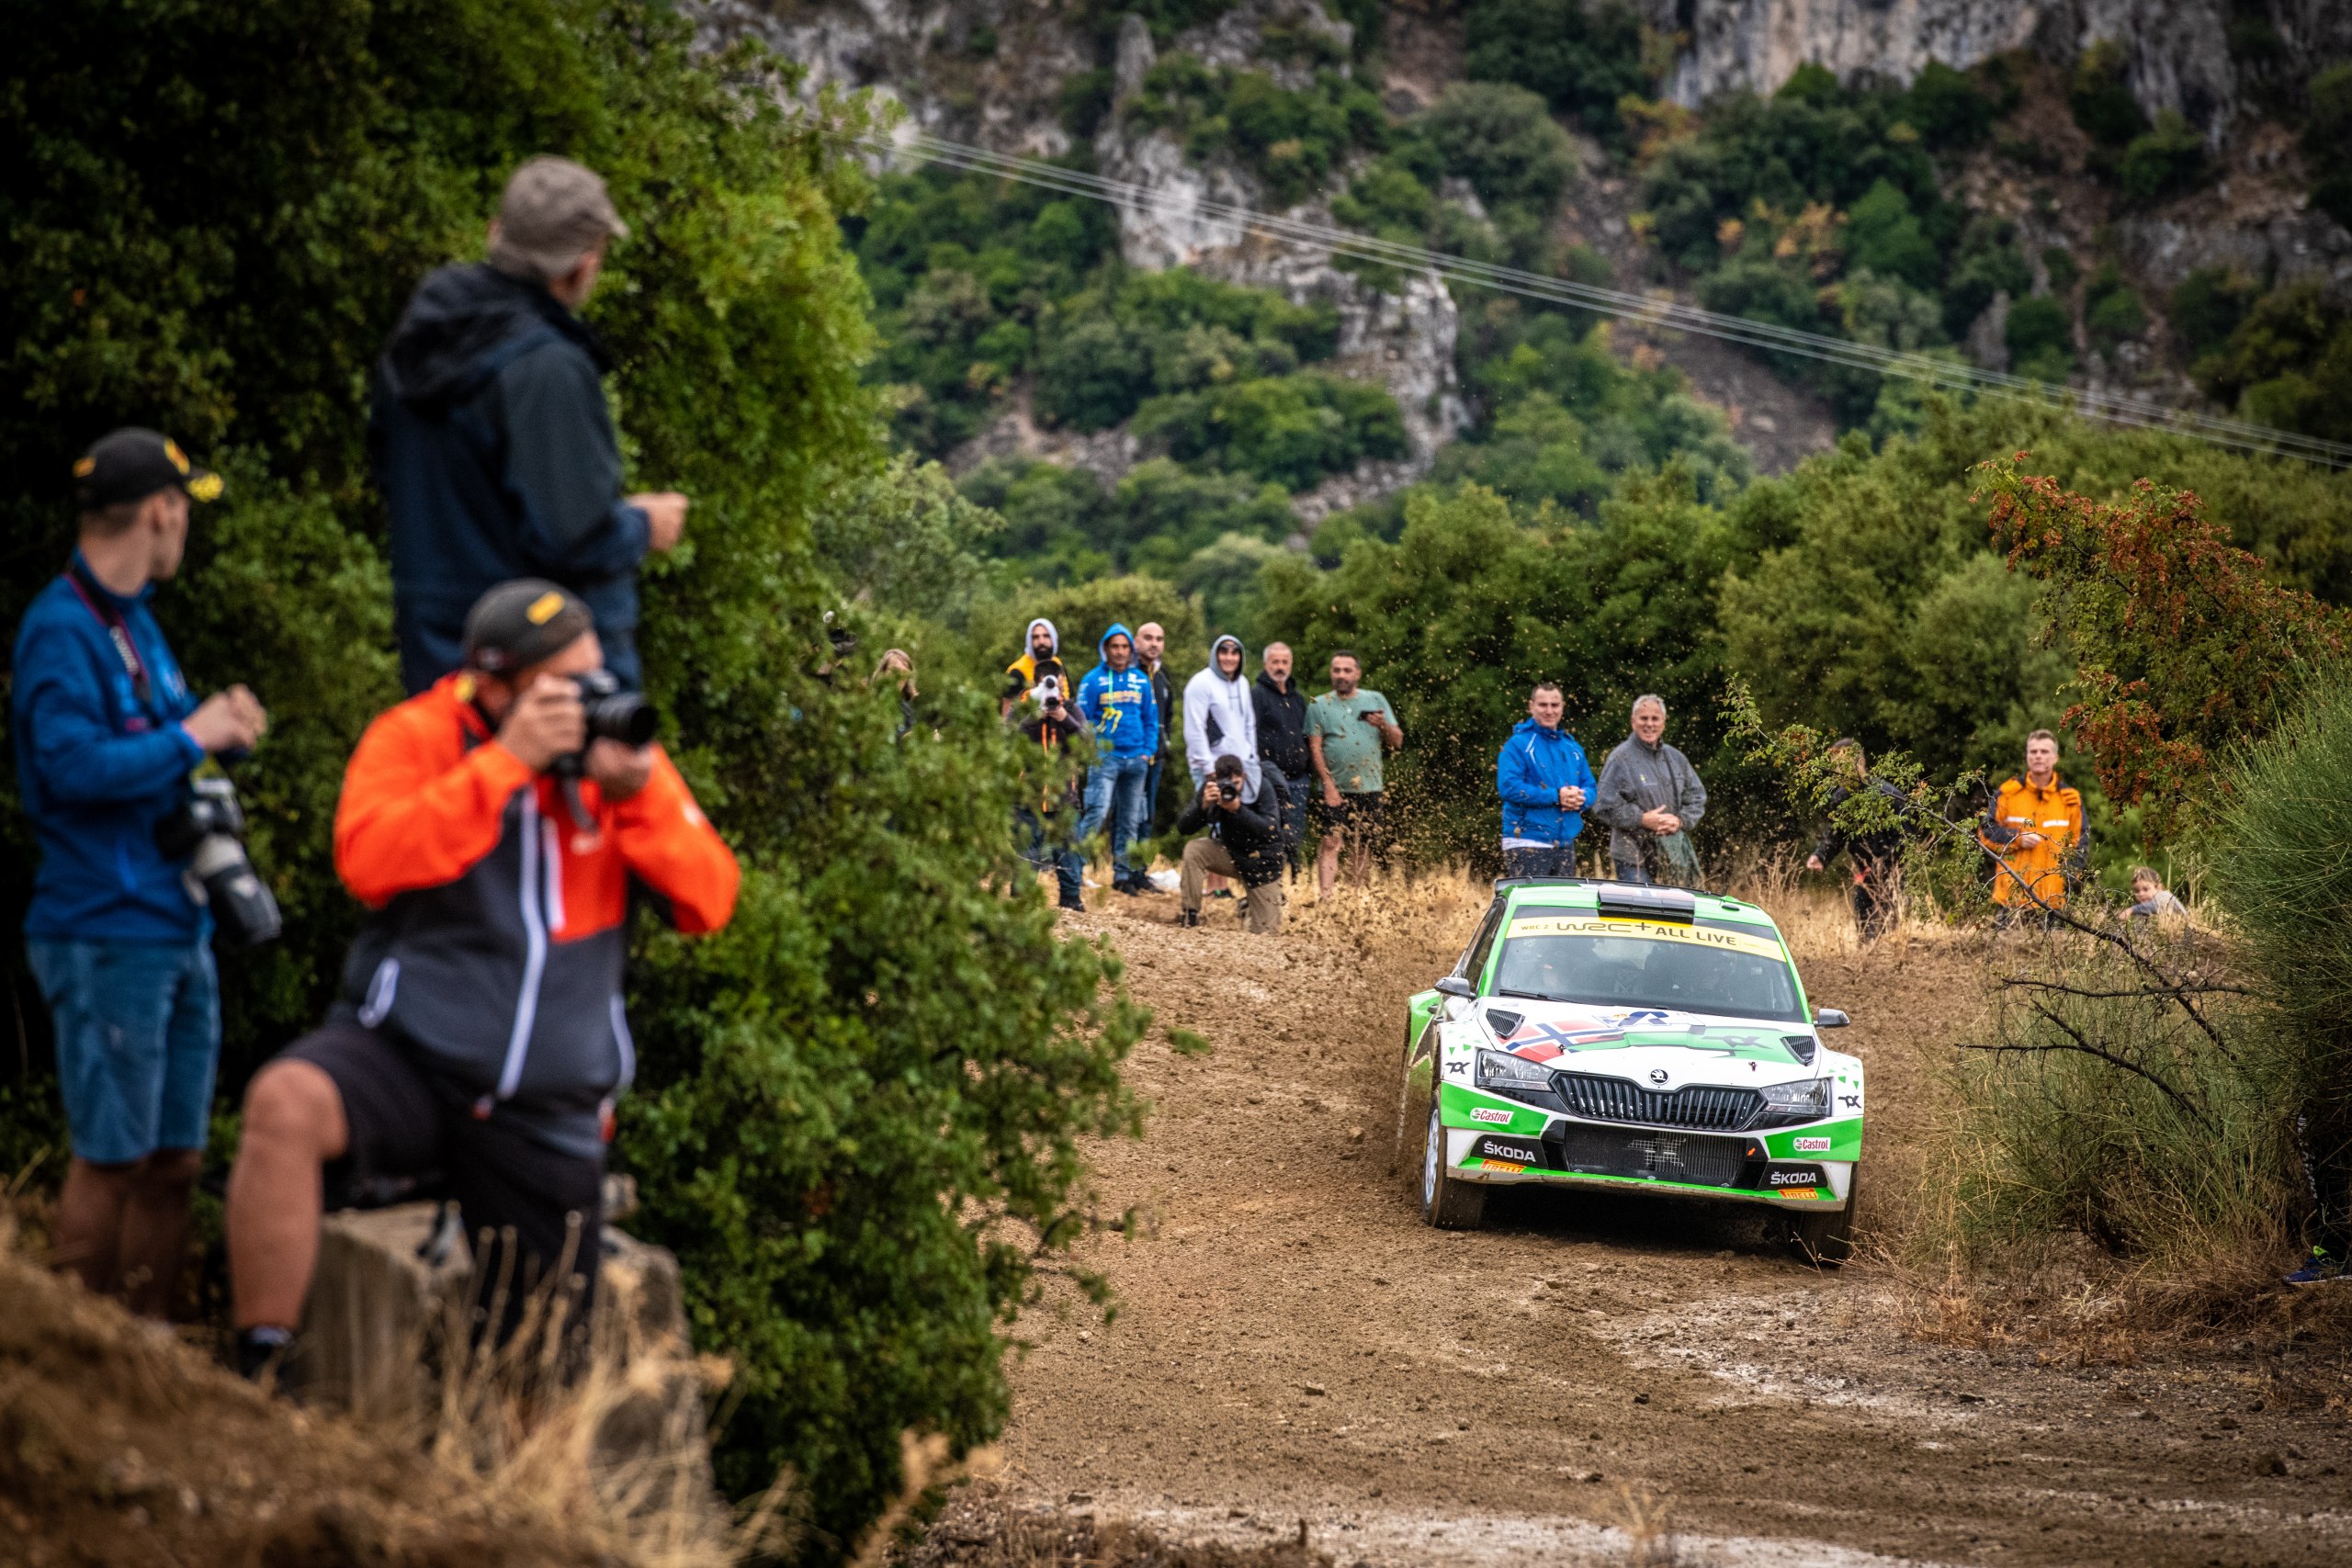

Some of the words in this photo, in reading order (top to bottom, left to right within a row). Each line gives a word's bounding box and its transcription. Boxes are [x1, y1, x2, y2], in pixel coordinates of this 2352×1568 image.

[1656, 927, 1690, 939] ALL
[1696, 931, 1737, 946] LIVE
[1480, 1110, 1510, 1122] Castrol
[1484, 1140, 1536, 1162] ŠKODA
[1803, 1139, 1828, 1150] Castrol
[1480, 1158, 1526, 1173] PIRELLI
[1770, 1171, 1817, 1185] ŠKODA
[1779, 1188, 1818, 1199] PIRELLI
